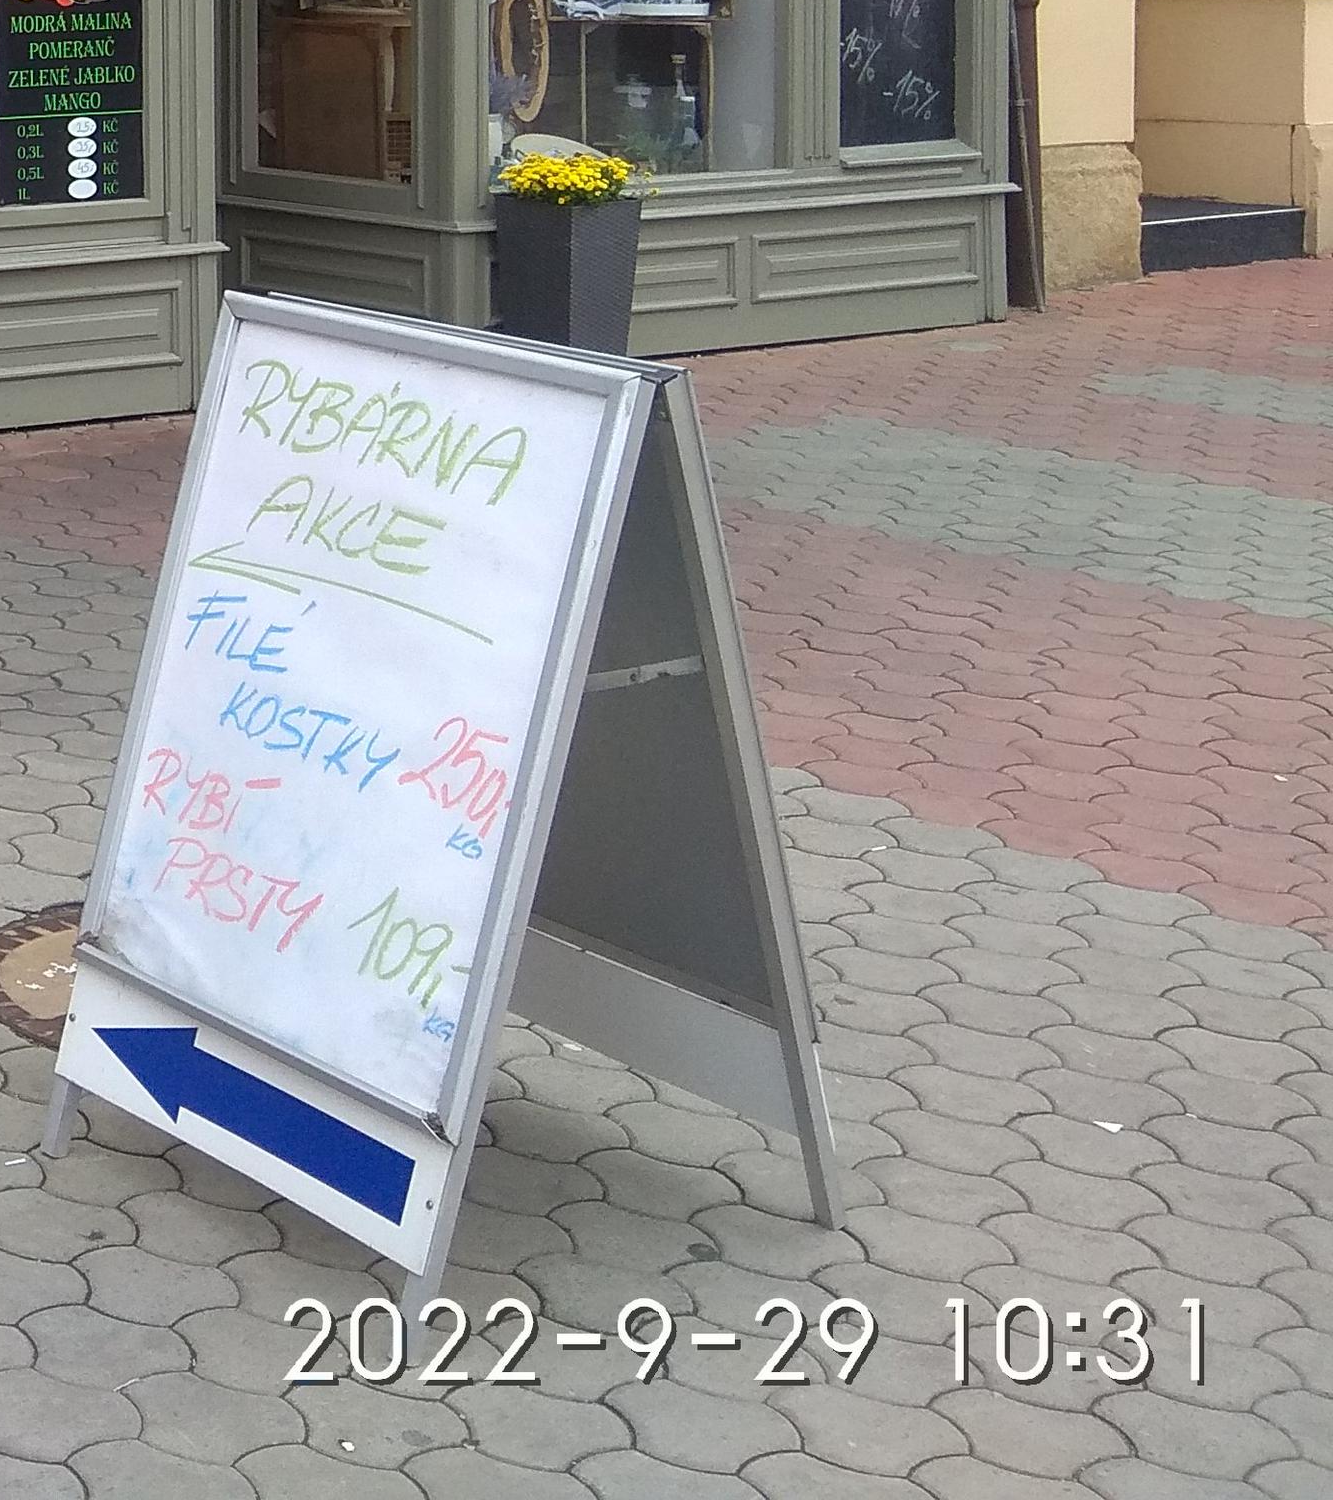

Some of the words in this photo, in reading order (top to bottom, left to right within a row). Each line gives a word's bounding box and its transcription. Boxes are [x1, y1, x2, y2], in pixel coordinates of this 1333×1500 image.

[10, 12, 67, 33] MODRÁ
[71, 12, 132, 31] MALINA
[29, 37, 115, 60] POMERANČ
[8, 65, 70, 88] ZELENÉ
[74, 65, 135, 85] JABLKO
[44, 92, 101, 111] MANGO
[103, 118, 118, 132] KČ
[103, 140, 118, 154] KČ
[103, 161, 119, 175] KČ
[103, 181, 119, 194] KČ
[238, 358, 527, 508] RYBÁRNA
[246, 475, 446, 575] AKCE
[185, 589, 316, 674] FILÉ
[220, 682, 403, 793] KOSTKY
[154, 836, 325, 954] PRSTY
